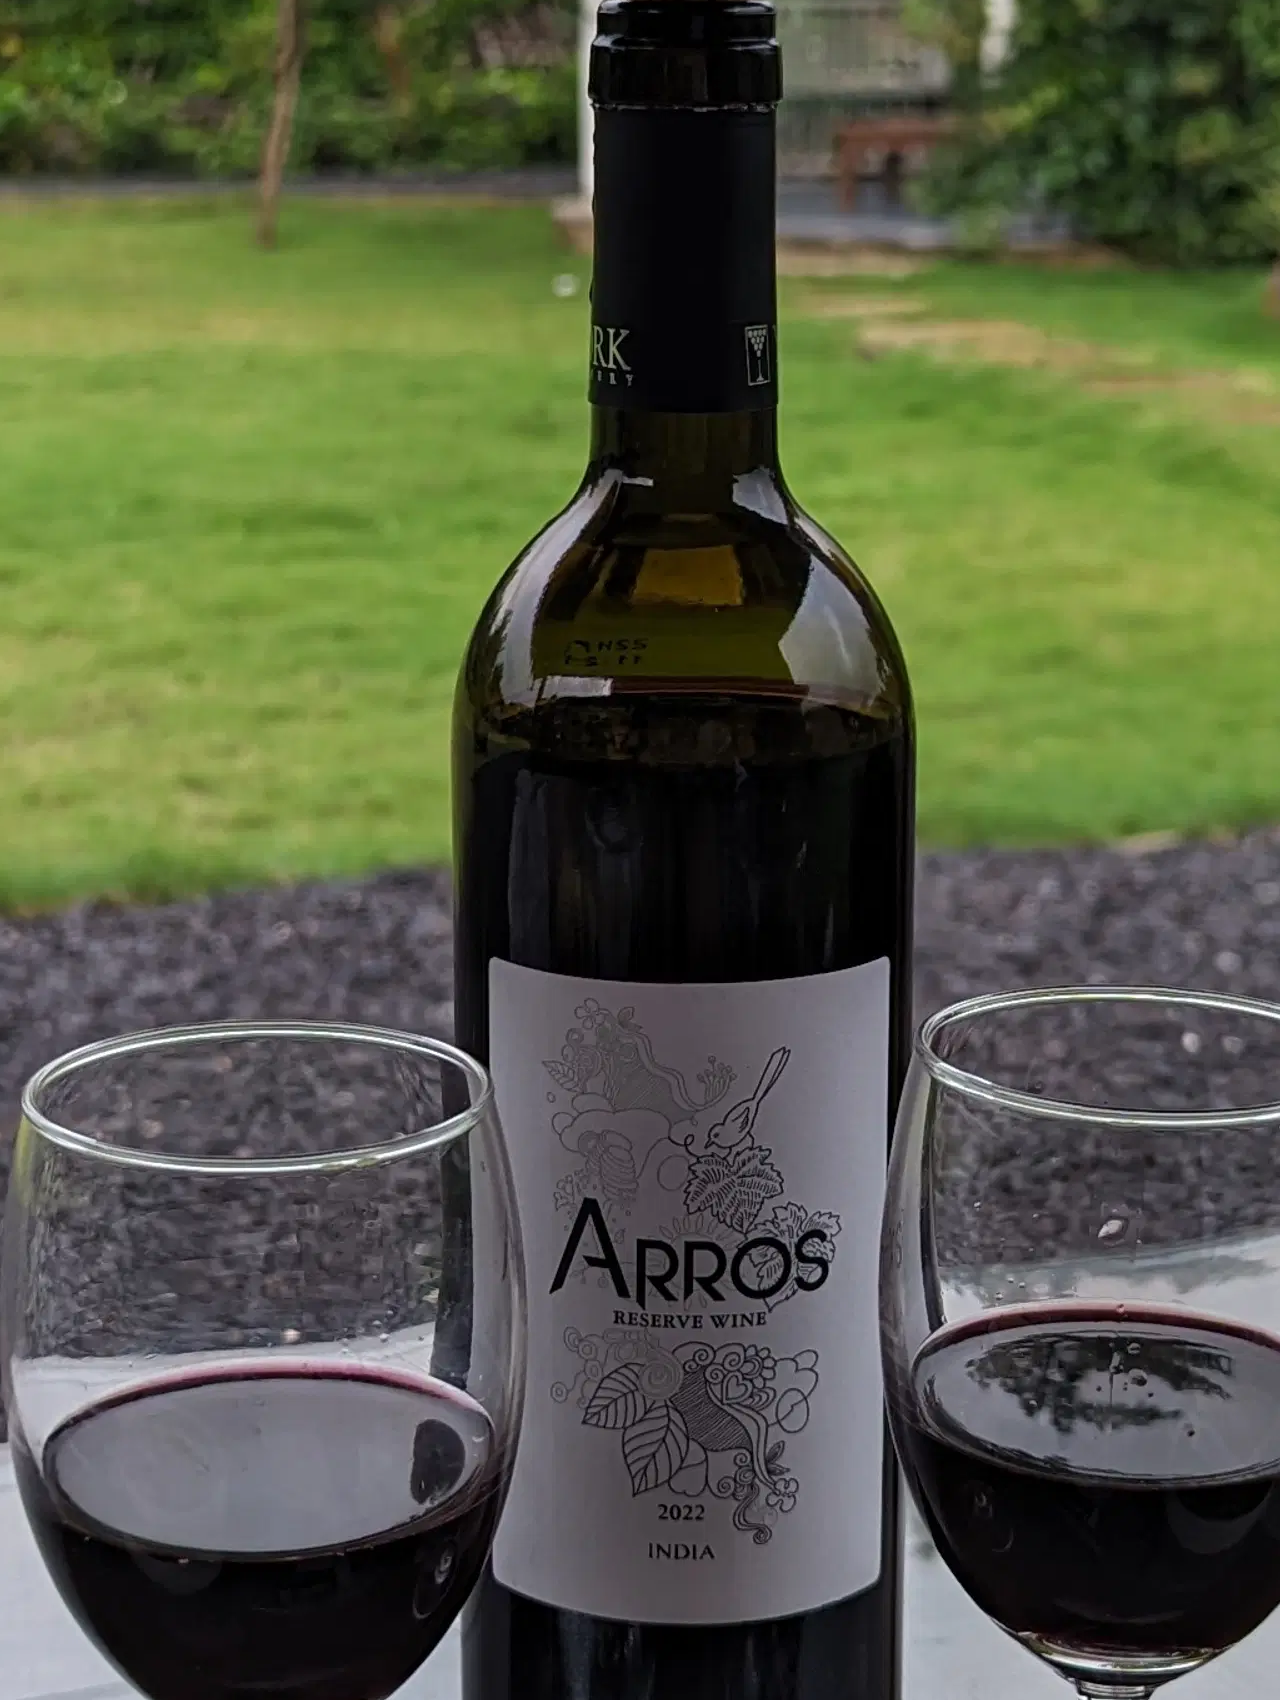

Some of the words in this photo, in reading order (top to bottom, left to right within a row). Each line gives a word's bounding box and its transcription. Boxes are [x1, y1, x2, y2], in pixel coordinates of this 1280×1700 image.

[549, 1197, 831, 1308] ARROS
[613, 1310, 703, 1330] RESERVE
[708, 1310, 768, 1329] WINE
[657, 1503, 705, 1521] 2022
[647, 1541, 716, 1561] INDIA
